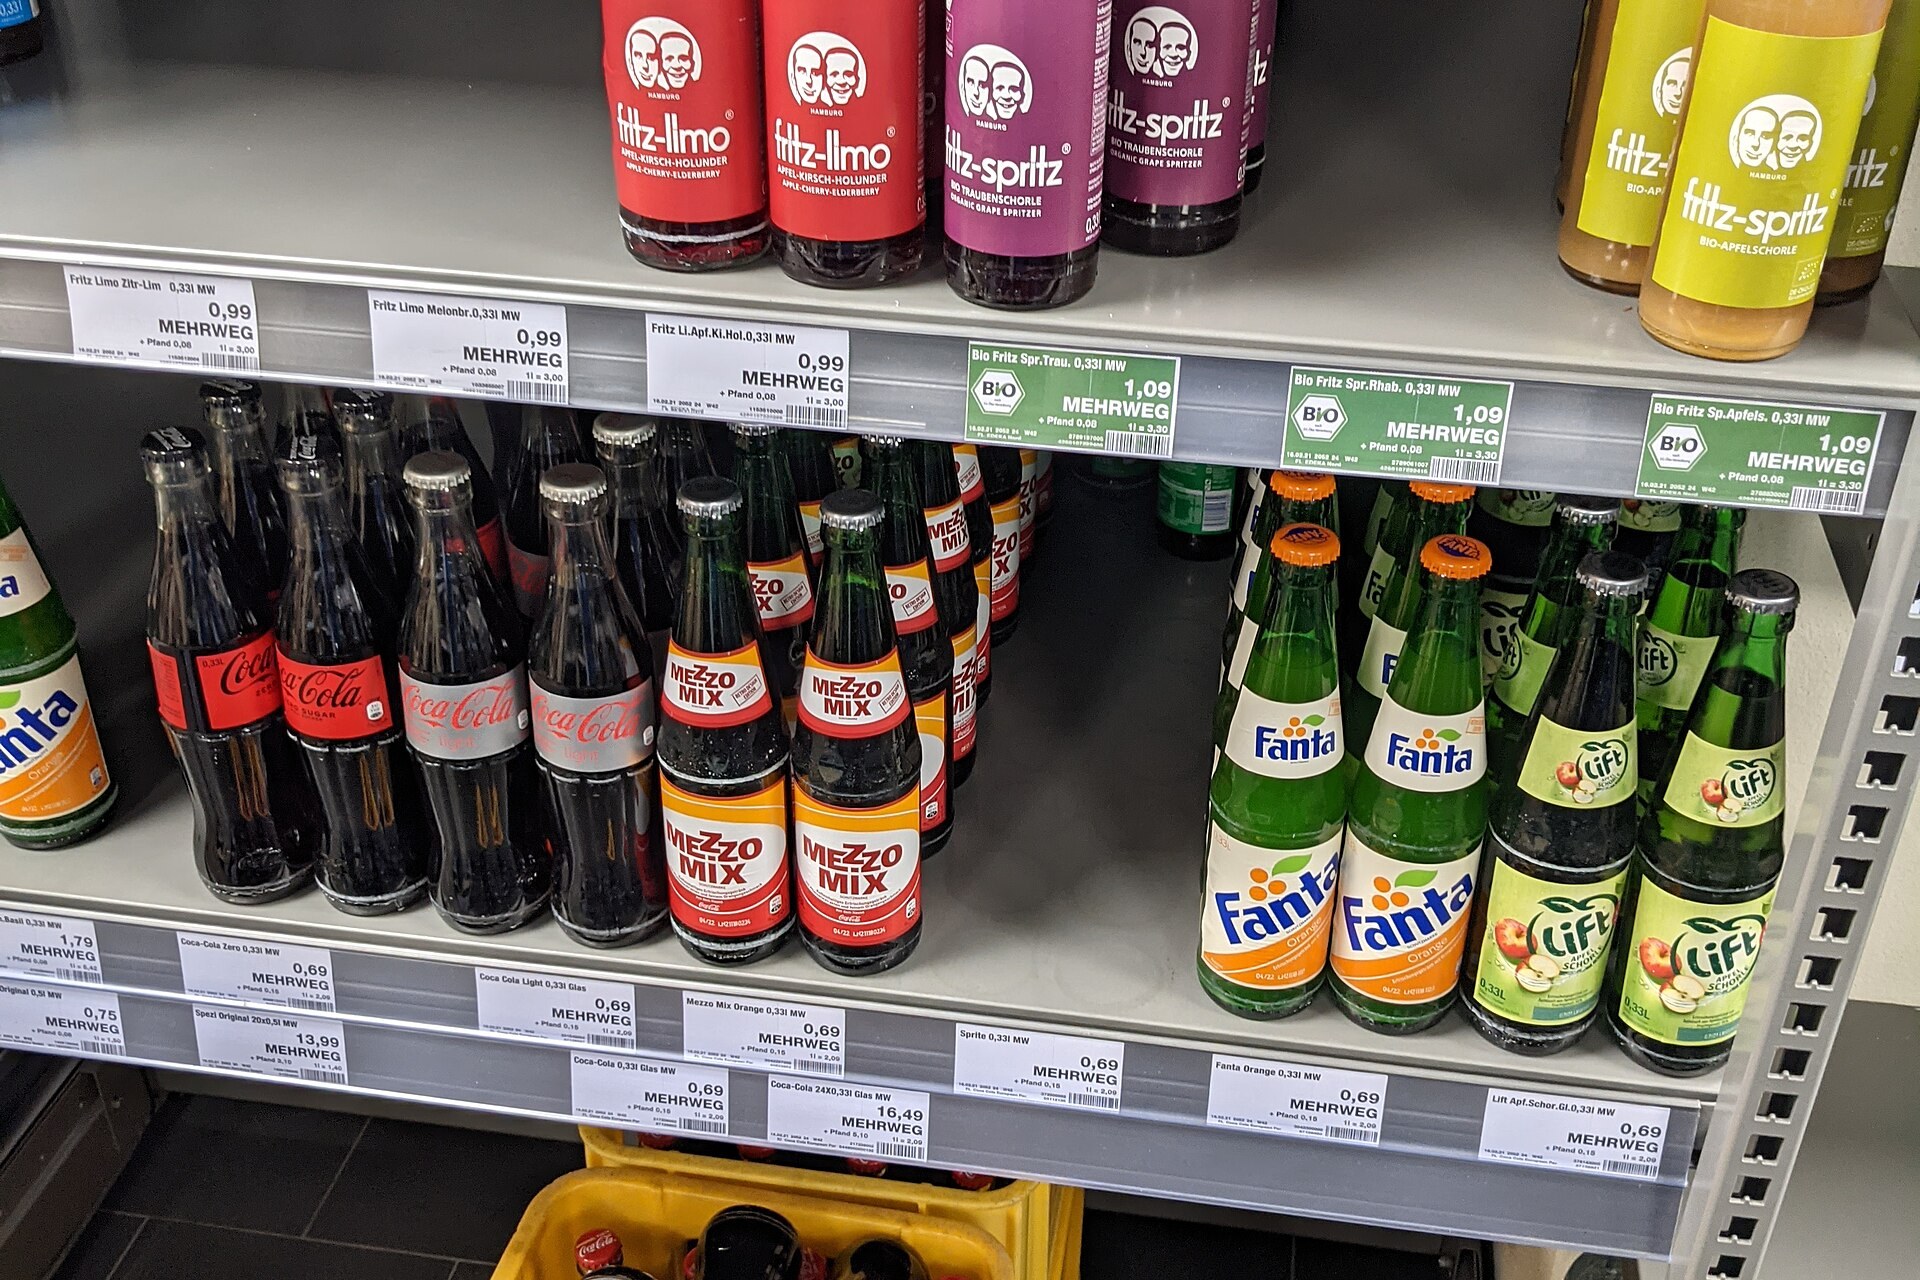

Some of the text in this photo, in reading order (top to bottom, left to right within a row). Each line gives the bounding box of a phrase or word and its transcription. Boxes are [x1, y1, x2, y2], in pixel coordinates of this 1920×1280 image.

[1142, 78, 1173, 88] HAMBURG
[648, 92, 680, 100] HAMBURG
[810, 108, 843, 117] HAMBURG
[1107, 90, 1223, 146] ritz-spritz
[617, 103, 730, 153] fritz-limo
[976, 120, 1007, 131] HAMBURG
[775, 118, 891, 170] fritz-limo
[1111, 137, 1202, 157] BIO TRAUBENSCHORLE
[621, 149, 728, 167] APFEL-KIRSCH-HOLUNDER
[1110, 149, 1202, 168] ORGANIC GRAPE SPRITZER
[626, 162, 720, 179] APPLE-CHERRY-ELDERBERRY
[777, 166, 887, 185] APFEL-KIRSCH-HOLUNDER
[1749, 172, 1787, 181] HAMBURG
[783, 179, 879, 196] APPLE-CHERRY-ELDERBERRY
[962, 187, 1042, 205] TRAUBENSCHORLE
[950, 192, 1041, 217] ORGANIC GRAPE SPRITZER
[1681, 177, 1829, 244] fritz-spritz
[1700, 236, 1798, 255] BIO-APFELSCHORLE
[70, 274, 215, 295] Fritz Limo Zitr-Lim 0,33l MW
[209, 302, 251, 321] 0,99
[373, 300, 396, 312] Fritz
[400, 302, 424, 314] Limo
[501, 311, 520, 321] MW
[159, 319, 254, 340] MEHRWEG
[517, 329, 561, 348] 0,99
[652, 323, 675, 334] Fritz
[776, 334, 795, 344] MW
[463, 347, 562, 368] MEHRWEG
[799, 353, 844, 373] 0,99
[972, 350, 1126, 372] Bio Fritz Spr.Trau. 0,33l MW
[742, 370, 844, 392] MEHRWEG
[1125, 379, 1171, 400] 1,09
[1295, 374, 1461, 397] Bio Fritz Spr.Rhab. 0,33l MW
[1063, 396, 1170, 419] MEHRWEG
[1454, 404, 1503, 426] 1,09
[1653, 403, 1830, 426] Bio Fritz Sp.Apfels. 0,33l MW
[1387, 422, 1500, 445] MEHRWEG
[1819, 434, 1871, 455] 1,09
[1748, 452, 1866, 476] MEHRWEG
[671, 662, 735, 688] MEZZO
[813, 676, 882, 698] MEZZO
[301, 708, 335, 718] SUGAR
[1255, 726, 1335, 760] Fanta
[1388, 733, 1472, 773] Fanta
[666, 818, 762, 861] MEZZO
[802, 833, 903, 872] MEZZO
[1215, 853, 1337, 945] Fanta
[1343, 874, 1473, 951] Fanta
[60, 935, 93, 948] 1,79
[181, 938, 221, 949] Coca-Cola
[223, 943, 240, 952] Zero
[265, 948, 280, 956] MW
[1408, 938, 1448, 962] Orange
[20, 944, 96, 961] MEHRWEG
[1571, 949, 1594, 962] APFEL
[293, 963, 327, 977] 0,69
[1716, 969, 1740, 982] APFEL
[252, 973, 329, 991] MEHRWEG
[480, 973, 587, 992] Coca Cola Light 0,33l Glas
[1480, 978, 1505, 1000] 0,33L
[84, 1007, 117, 1021] 0,75
[595, 998, 631, 1013] 0,69
[686, 998, 806, 1018] Mezzo Mix Orange 0,33l MW
[1625, 996, 1650, 1020] 0,33L
[46, 1017, 119, 1034] MEHRWEG
[195, 1010, 217, 1019] Spezi
[219, 1012, 250, 1022] Original
[283, 1020, 298, 1028] MW
[552, 1008, 632, 1026] MEHRWEG
[804, 1023, 840, 1037] 0,69
[960, 1030, 1029, 1044] Sprite 0,33l MW
[296, 1034, 339, 1048] 13,99
[759, 1033, 840, 1051] MEHRWEG
[265, 1044, 341, 1062] MEHRWEG
[574, 1056, 615, 1068] Coca-Cola
[617, 1062, 638, 1071] 0,33l
[640, 1065, 658, 1073] Glas
[1080, 1056, 1118, 1070] 0,69
[1216, 1062, 1321, 1081] Fanta Orange 0,33l MW
[1033, 1066, 1117, 1085] MEHRWEG
[688, 1082, 723, 1096] 0,69
[771, 1080, 813, 1092] Coca-Cola
[855, 1091, 873, 1099] Glas
[875, 1093, 891, 1101] MW
[1340, 1089, 1380, 1104] 0,69
[645, 1092, 724, 1110] MEHRWEG
[1290, 1099, 1378, 1119] MEHRWEG
[1493, 1095, 1507, 1104] Lift
[1597, 1107, 1615, 1116] MW
[878, 1106, 923, 1121] 16,49
[842, 1116, 923, 1135] MEHRWEG
[1620, 1123, 1661, 1138] 0,69
[1567, 1133, 1658, 1153] MEHRWEG
